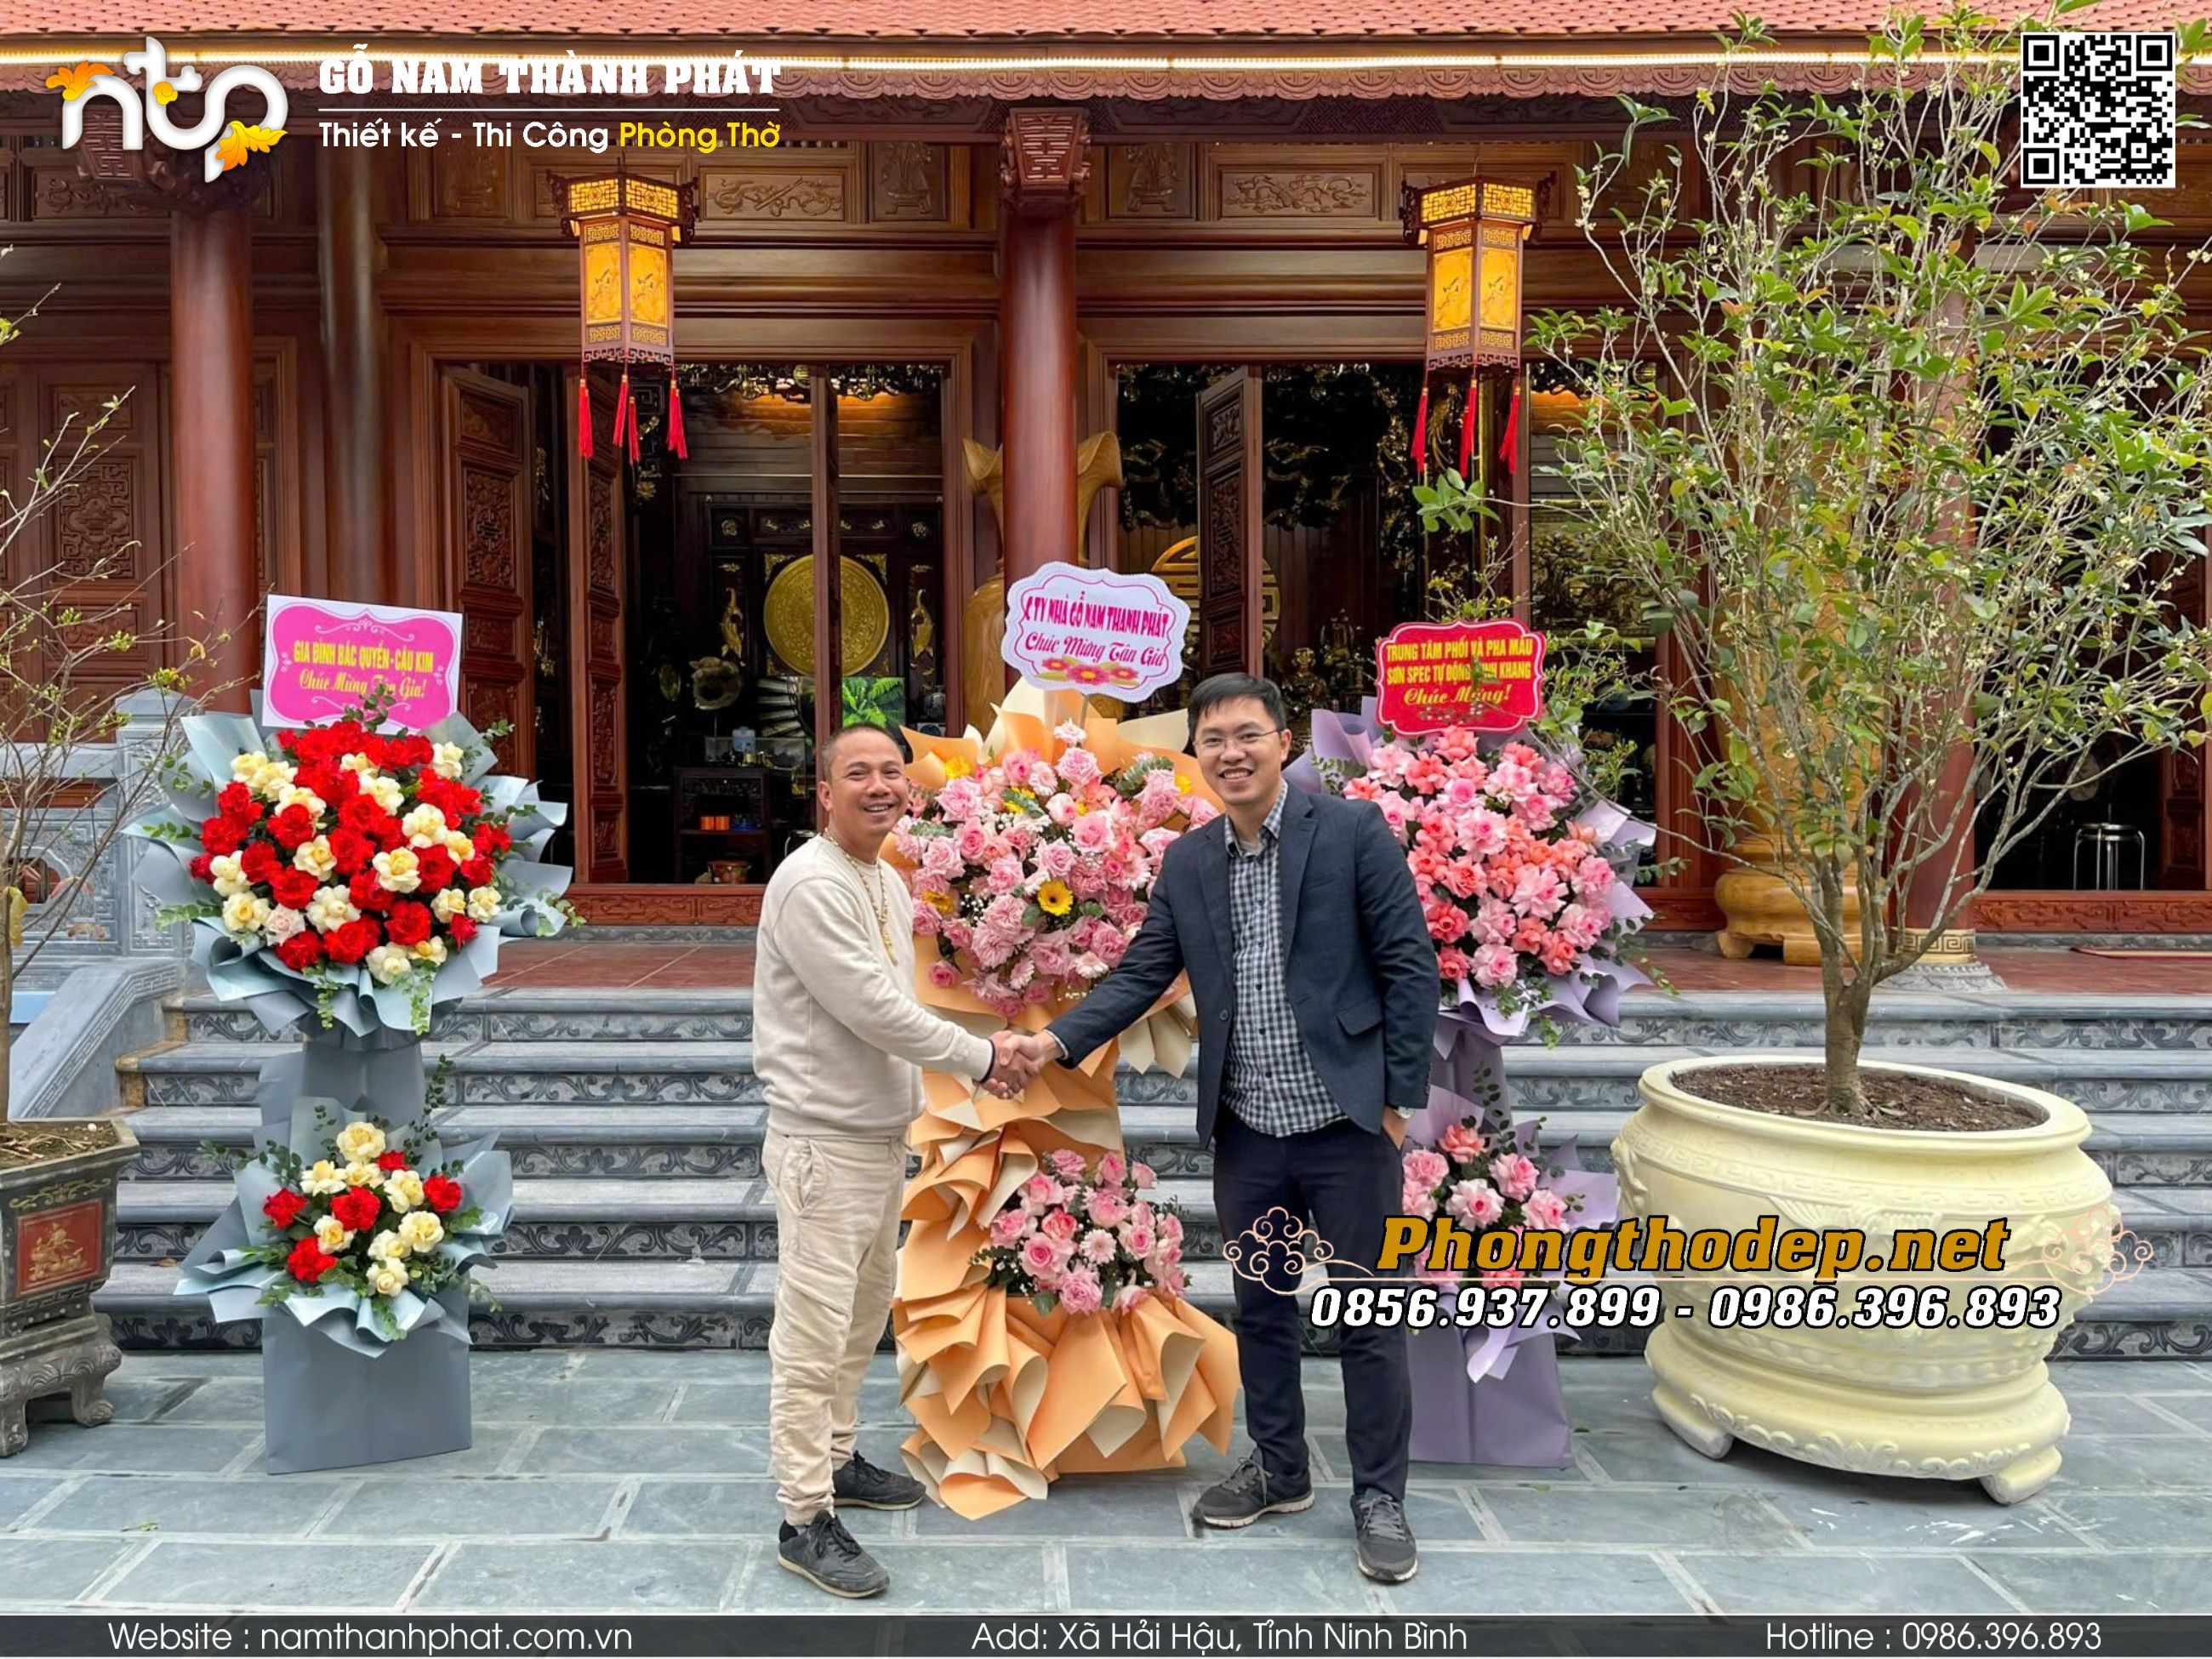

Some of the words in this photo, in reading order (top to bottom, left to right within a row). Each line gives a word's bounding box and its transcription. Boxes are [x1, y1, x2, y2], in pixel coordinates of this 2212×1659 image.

[1084, 601, 1106, 630] NAM
[293, 640, 311, 664] GIA
[338, 640, 357, 667] BÁC
[415, 651, 434, 674] KIM
[1025, 631, 1061, 653] Chúc
[1063, 636, 1107, 664] Mừng
[1109, 641, 1138, 664] Tân
[1386, 643, 1419, 663] TRUNG
[1420, 639, 1444, 661] TÂM
[1485, 638, 1507, 658] PHA
[299, 668, 330, 690] Chúc
[1406, 664, 1432, 685] SPEC
[1499, 660, 1532, 680] KHANG
[1404, 687, 1449, 706] Chúc
